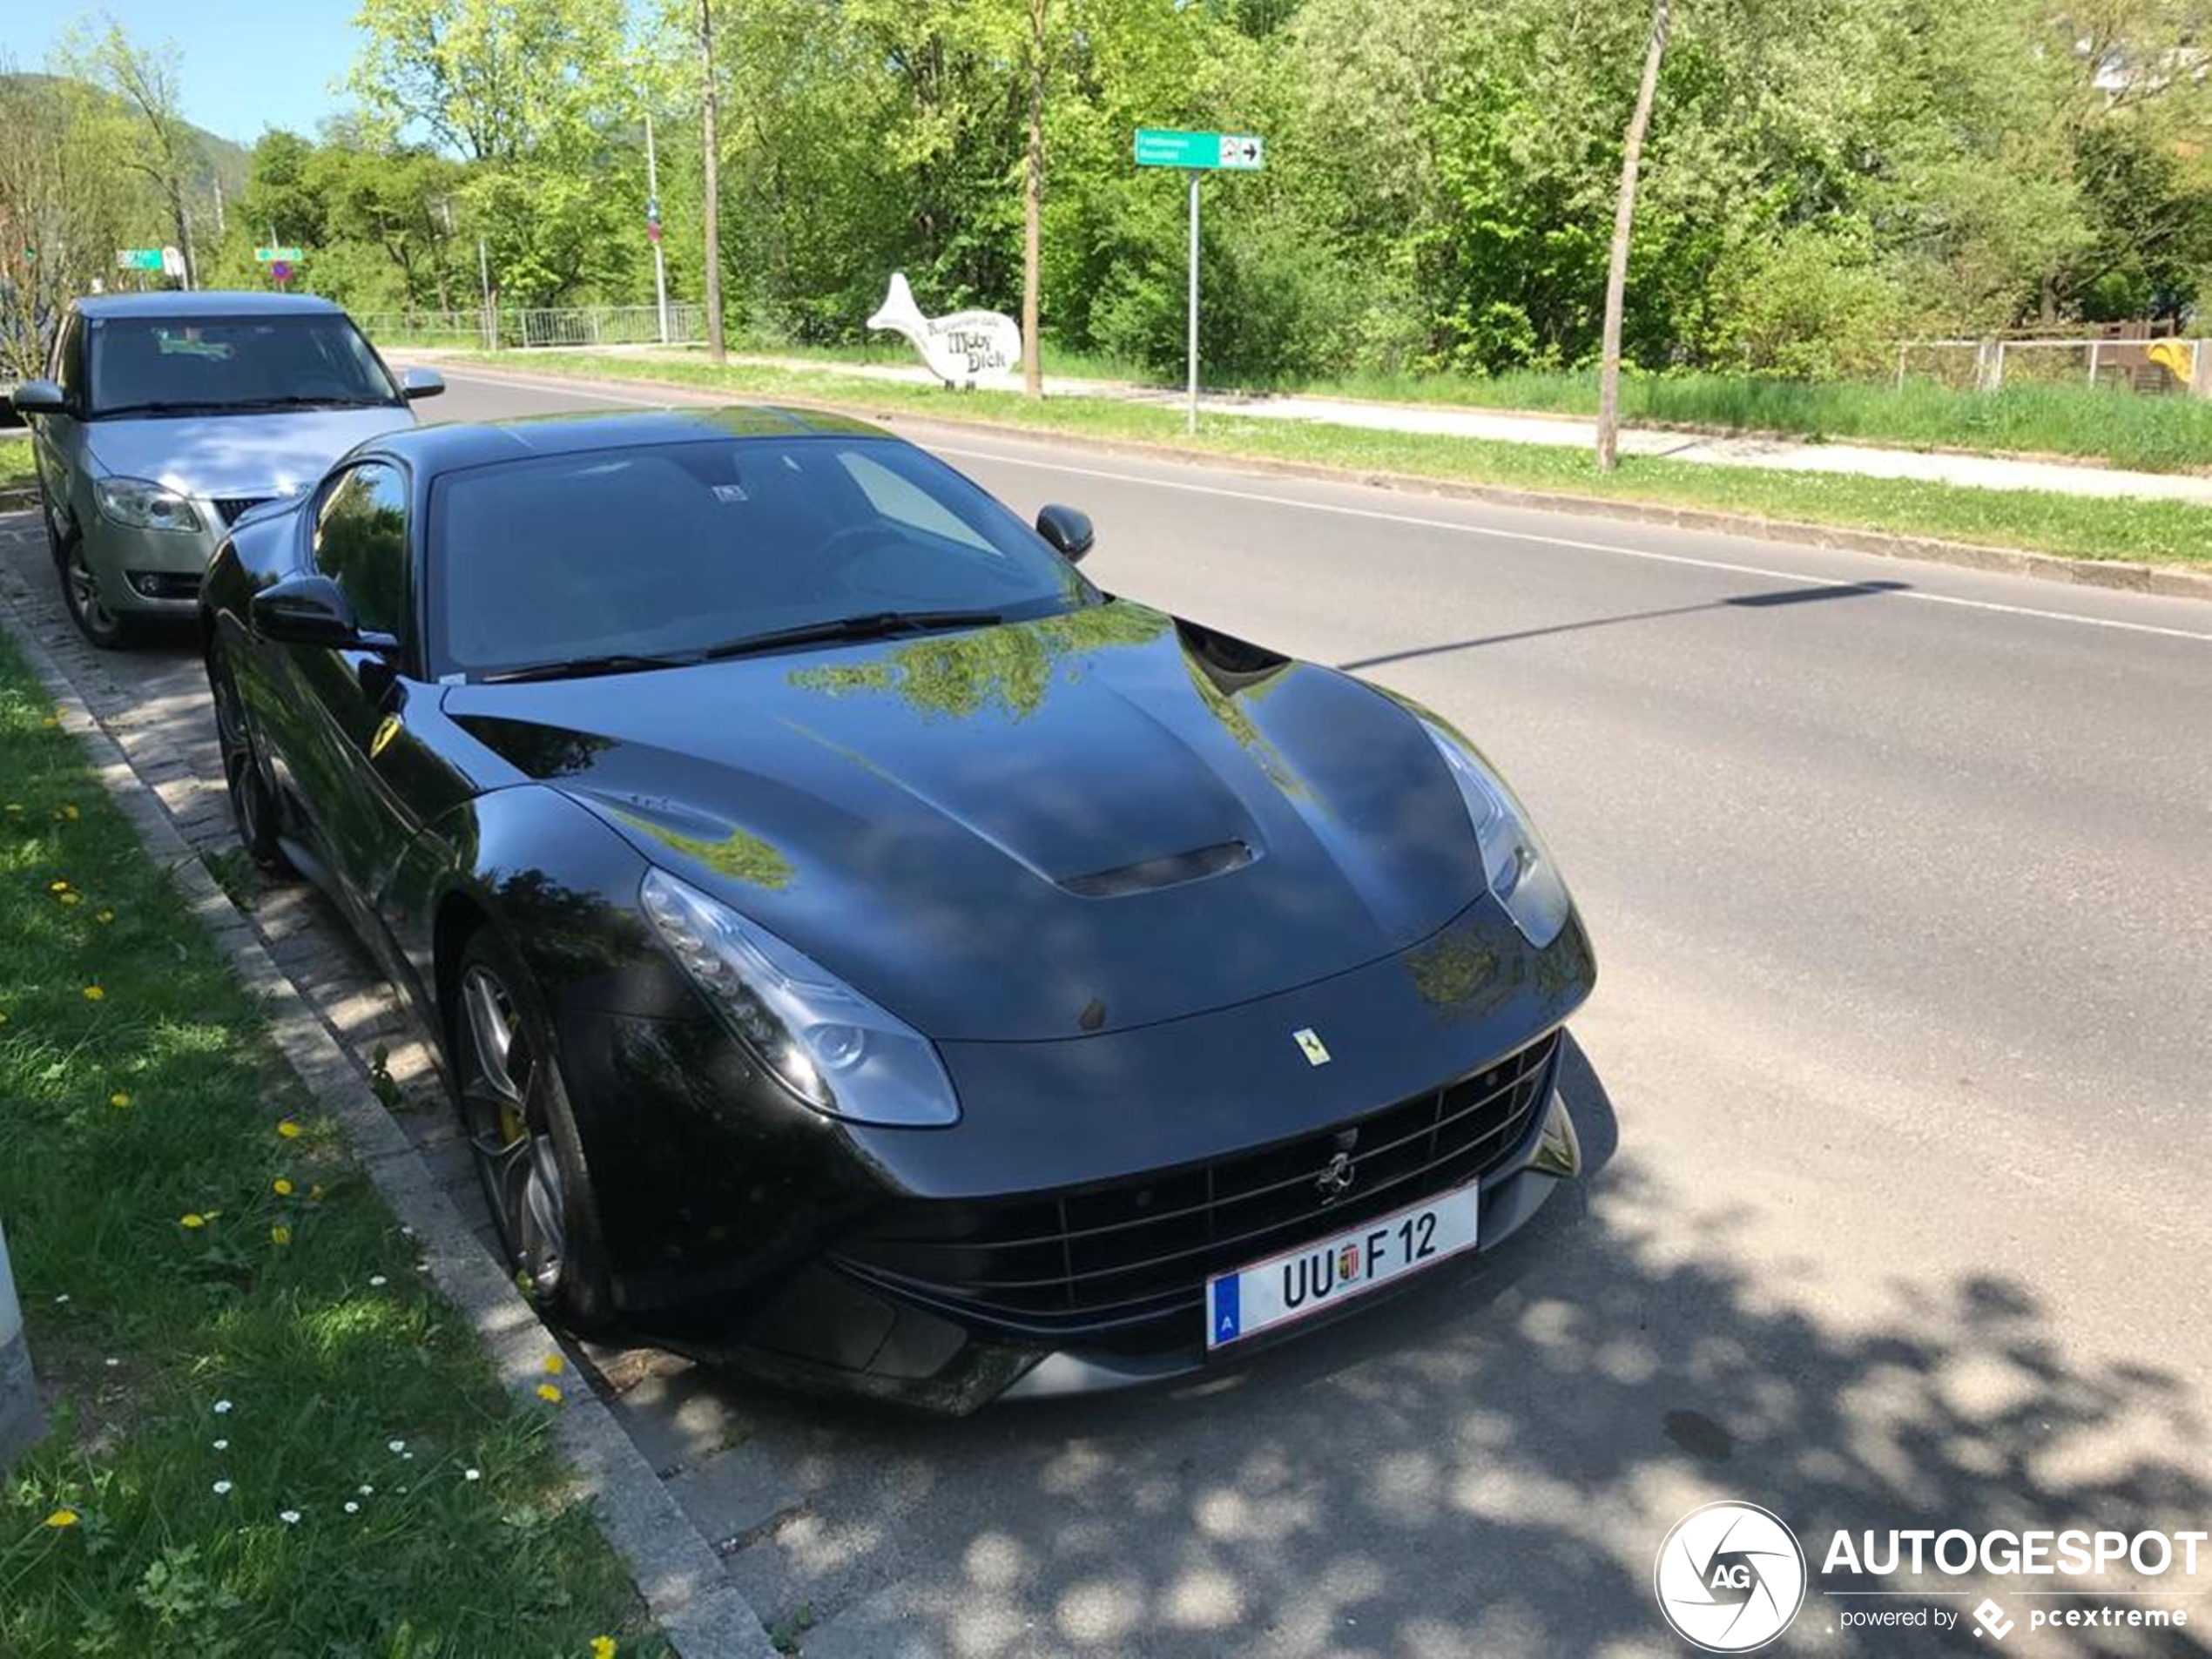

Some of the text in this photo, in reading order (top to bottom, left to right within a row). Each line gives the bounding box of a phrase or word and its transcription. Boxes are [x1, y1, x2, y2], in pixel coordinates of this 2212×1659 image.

[1285, 1212, 1436, 1308] UU F 12
[1221, 1317, 1233, 1330] A
